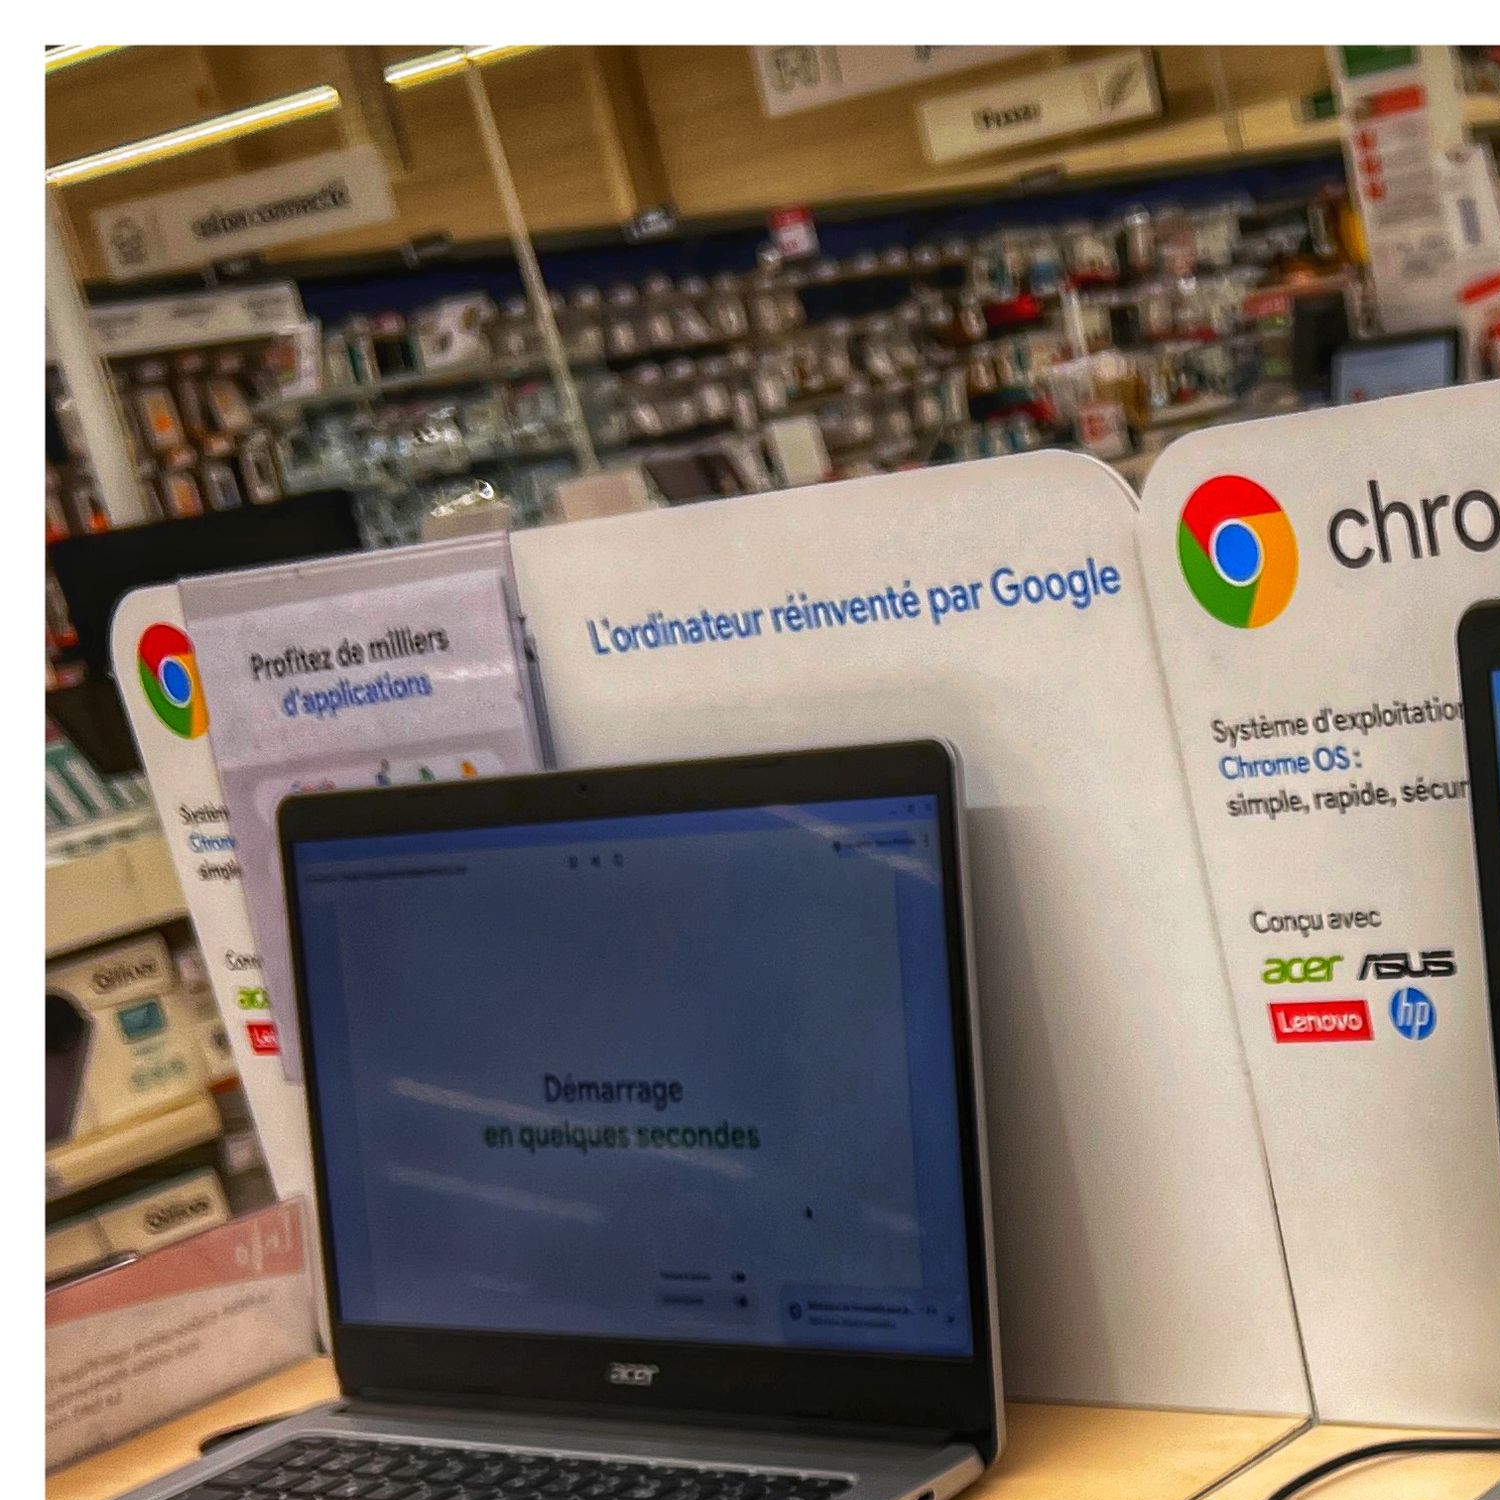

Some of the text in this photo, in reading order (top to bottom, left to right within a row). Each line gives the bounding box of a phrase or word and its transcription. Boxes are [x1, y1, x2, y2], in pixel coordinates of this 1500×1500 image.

[585, 557, 1122, 656] L'ordinateur réinventé par Google
[249, 626, 450, 683] Profitez de milliers
[282, 671, 434, 720] d'applications
[1210, 714, 1309, 748] Système
[1218, 745, 1351, 781] Chrome OS
[1225, 789, 1311, 821] simple,
[1313, 779, 1398, 815] rapide,
[1250, 909, 1382, 938] Conçu avec
[1261, 950, 1458, 985] acer ASUS
[1276, 1010, 1364, 1034] Lenovo
[543, 1072, 684, 1113] Démarrage
[483, 1119, 761, 1156] en quelques secondes
